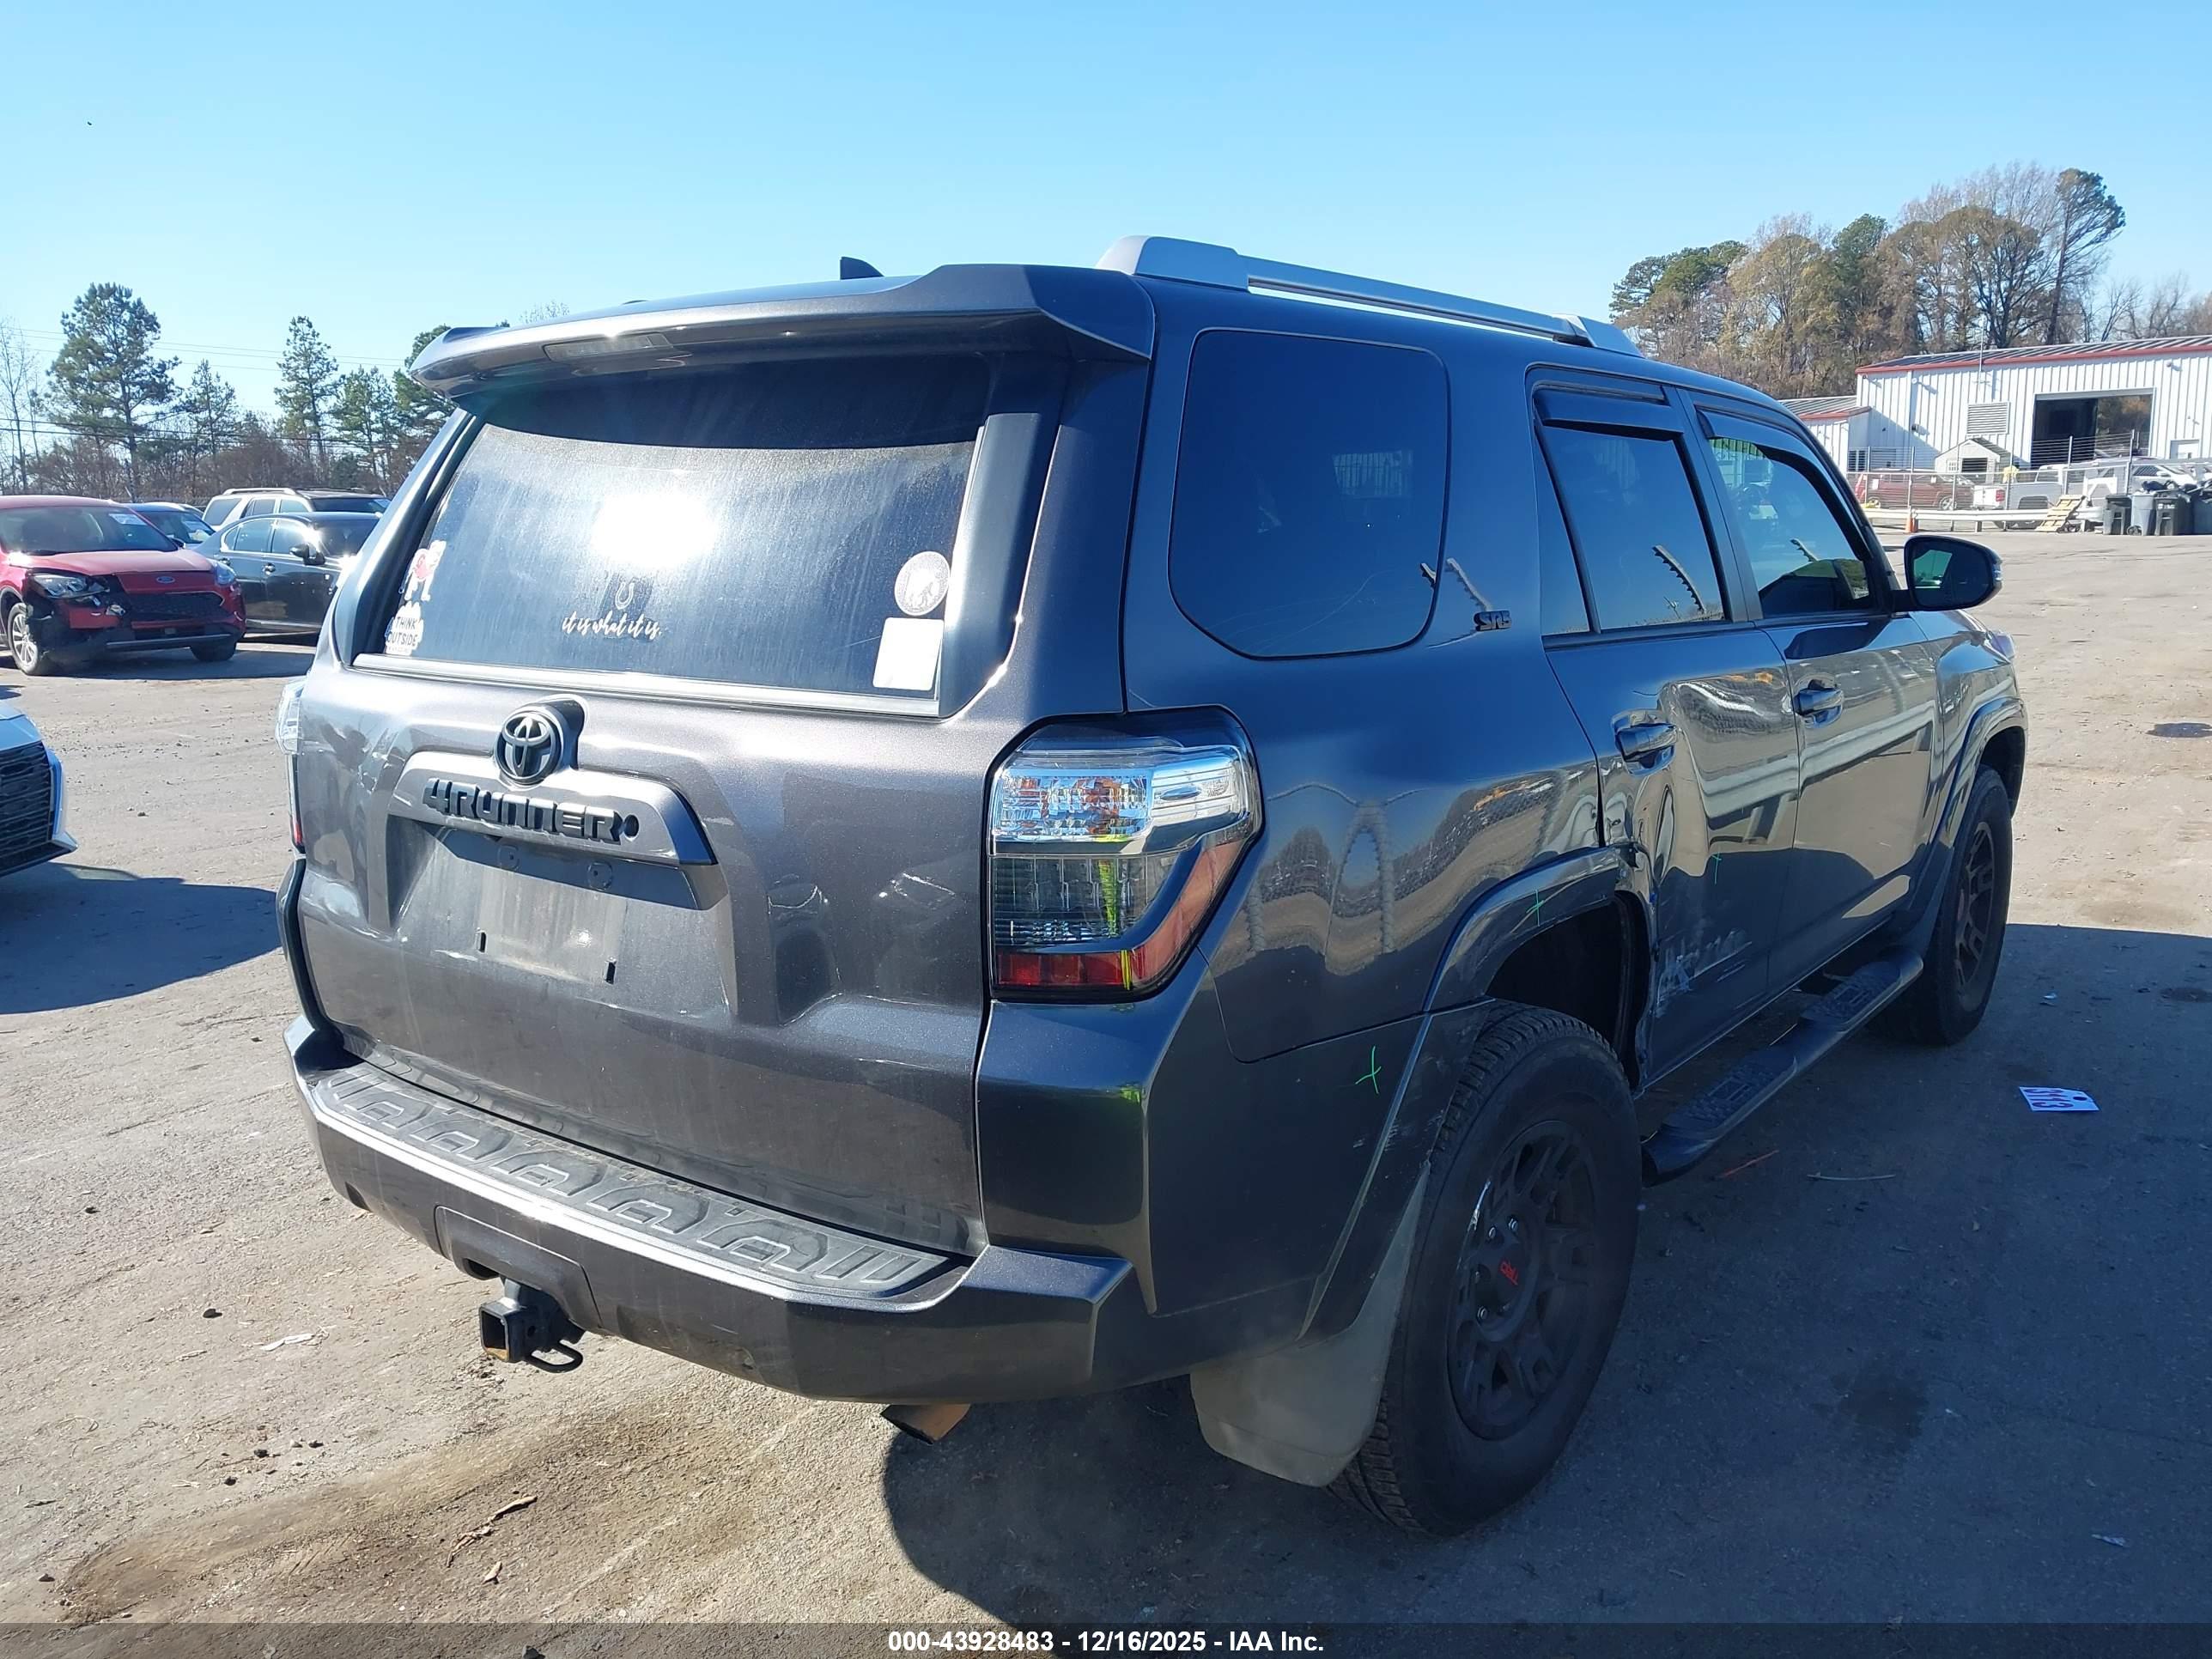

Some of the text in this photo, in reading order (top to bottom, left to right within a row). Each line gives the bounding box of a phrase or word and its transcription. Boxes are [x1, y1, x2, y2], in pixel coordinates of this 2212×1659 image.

[396, 617, 418, 629] THINK
[1474, 611, 1511, 631] SR5
[387, 630, 418, 646] OUTSIDE
[423, 777, 623, 845] 4RUNNER
